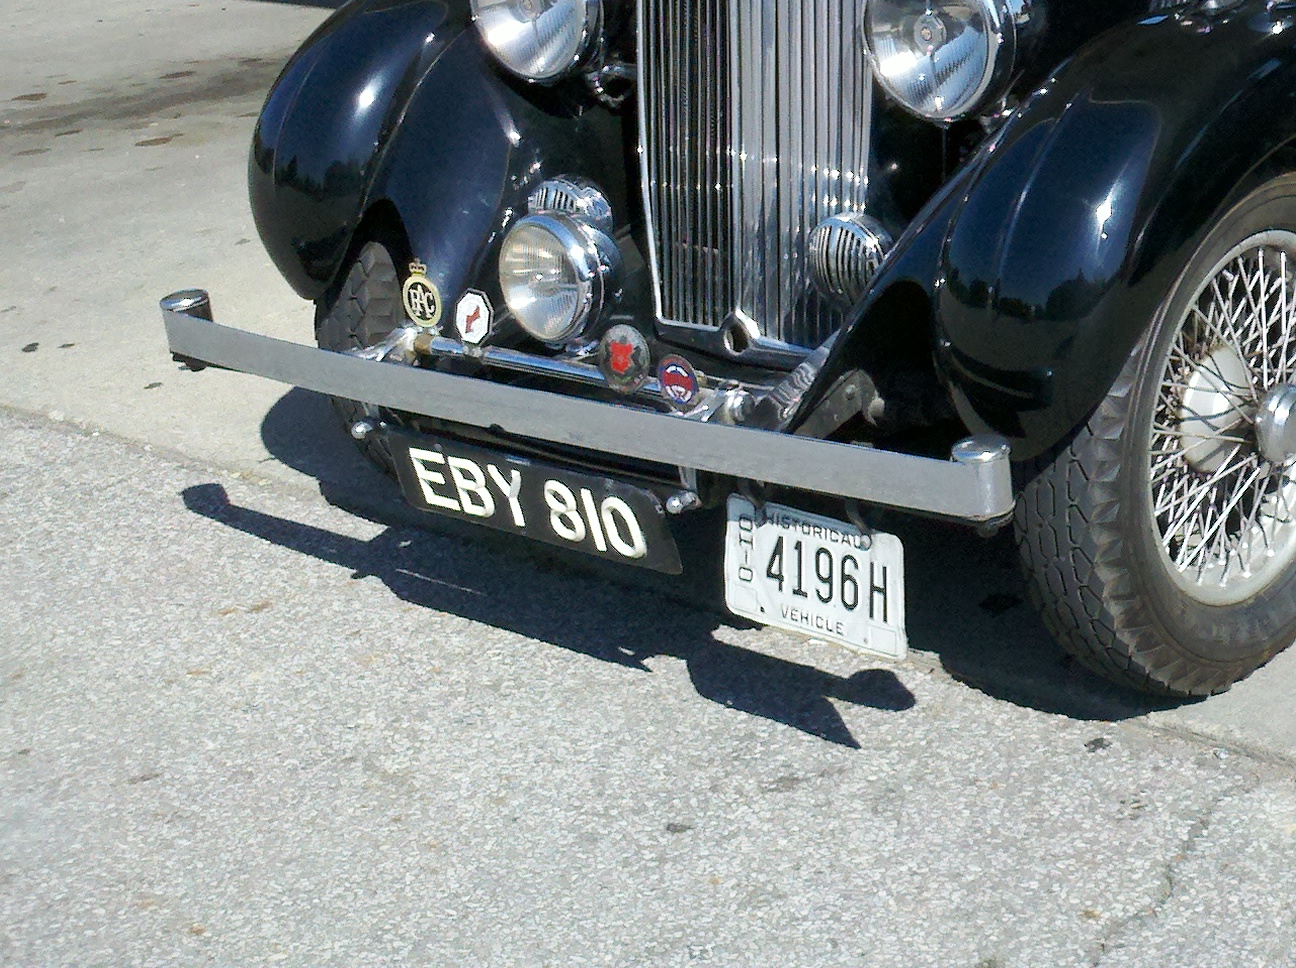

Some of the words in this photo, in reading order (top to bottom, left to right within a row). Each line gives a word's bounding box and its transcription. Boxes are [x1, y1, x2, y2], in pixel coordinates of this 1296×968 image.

[408, 447, 526, 527] EBY
[544, 479, 648, 559] 810
[739, 513, 755, 583] OHIO
[766, 535, 888, 624] 4196H
[780, 604, 845, 637] VEHICLE
